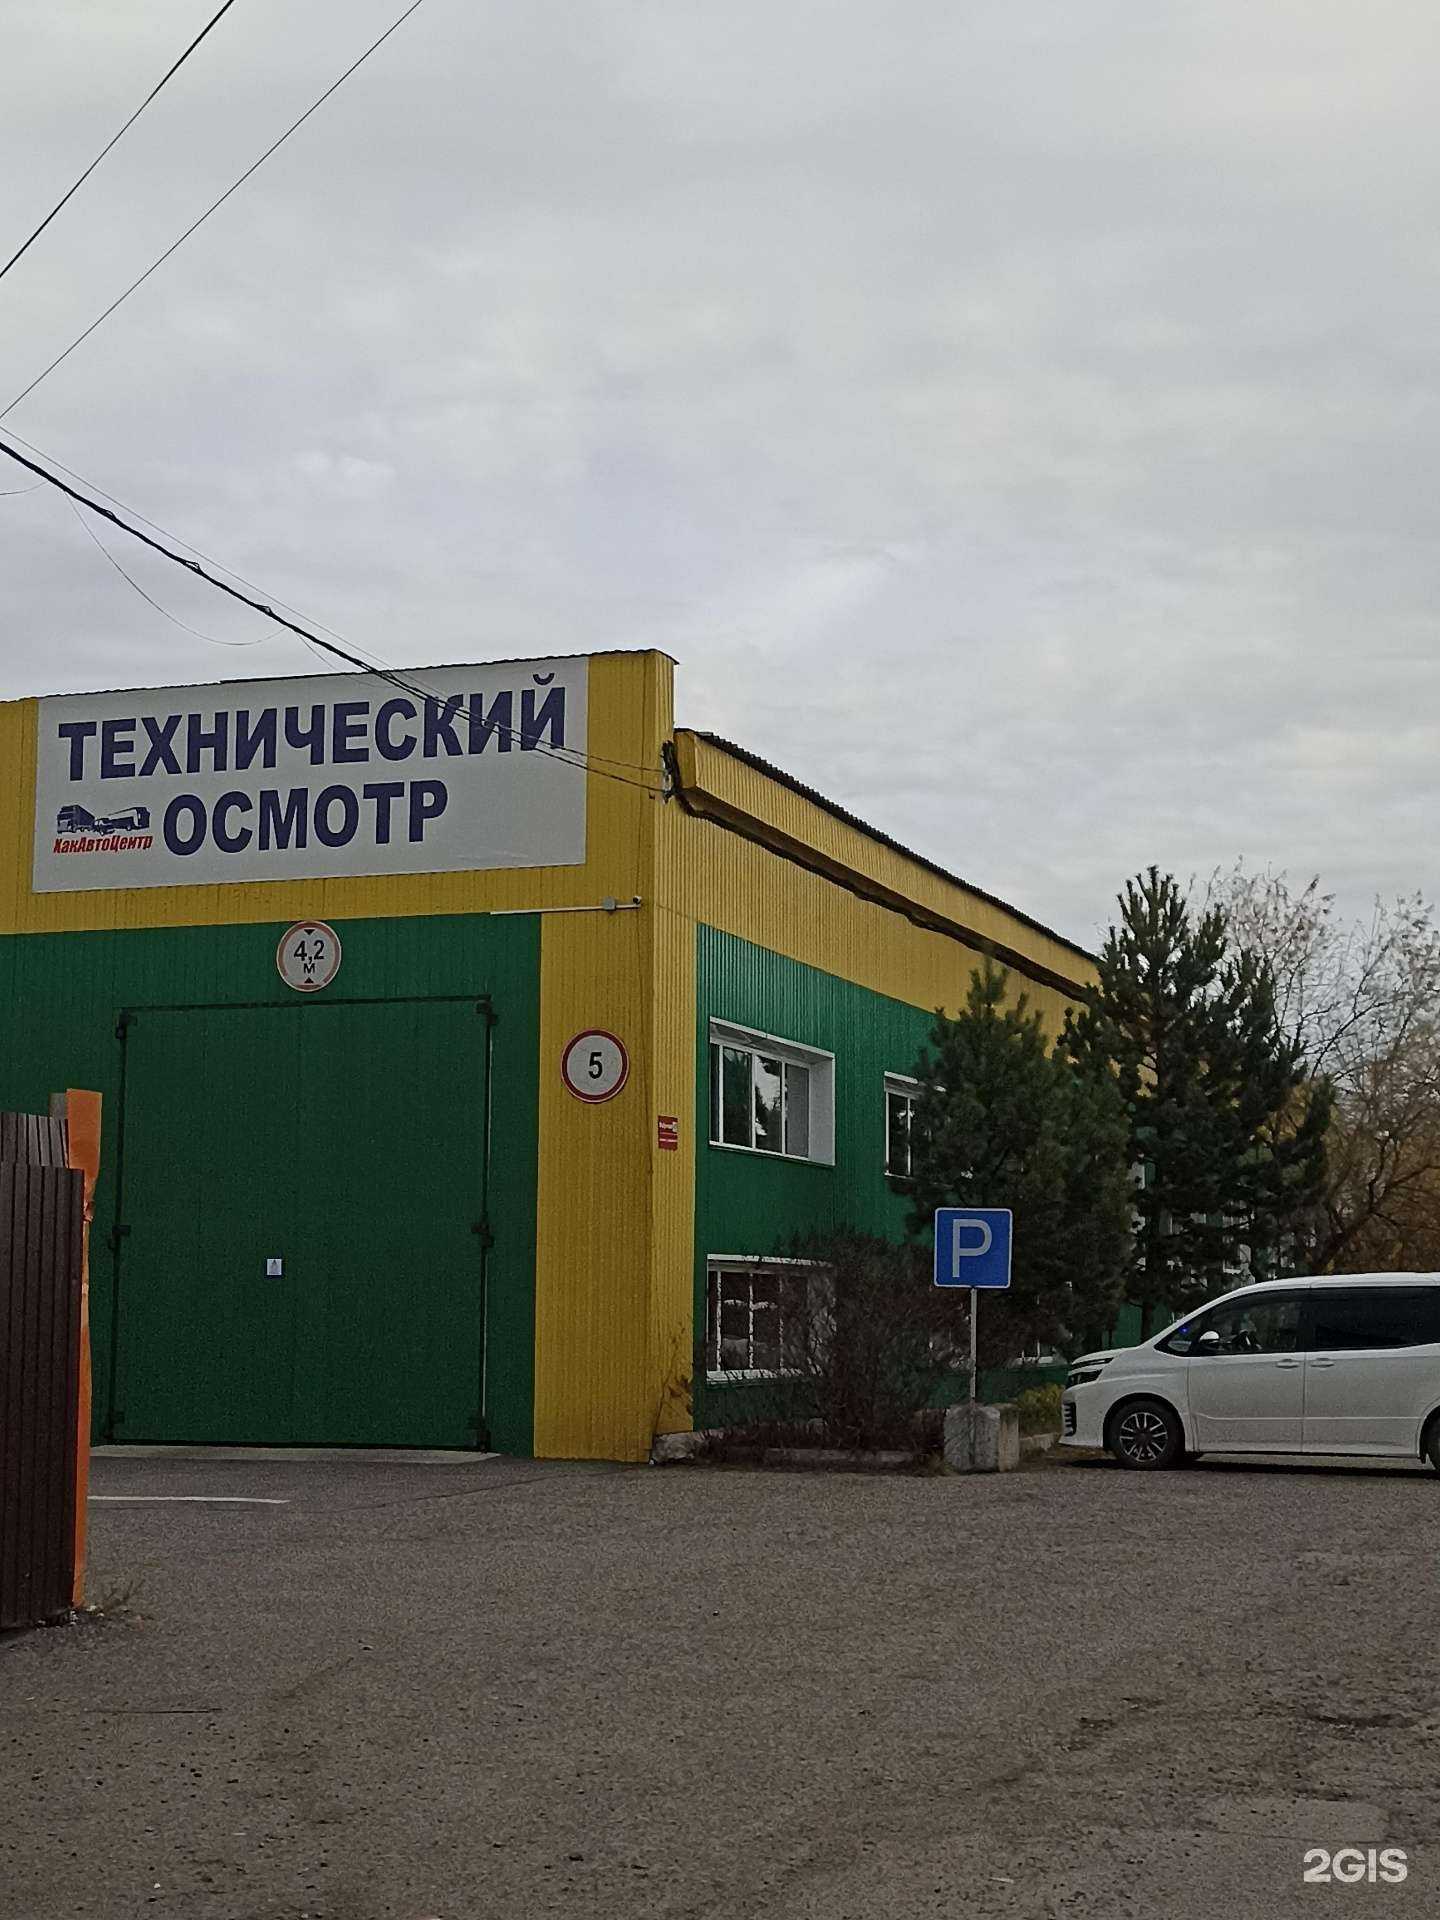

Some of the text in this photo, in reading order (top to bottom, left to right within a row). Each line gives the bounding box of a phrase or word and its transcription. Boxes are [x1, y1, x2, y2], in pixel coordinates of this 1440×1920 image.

[58, 672, 566, 781] ТЕХНИЧЕСКИЙ
[163, 779, 448, 855] ОСМОТР
[294, 940, 325, 964] 4,2
[589, 1052, 603, 1079] 5
[952, 1218, 992, 1278] P
